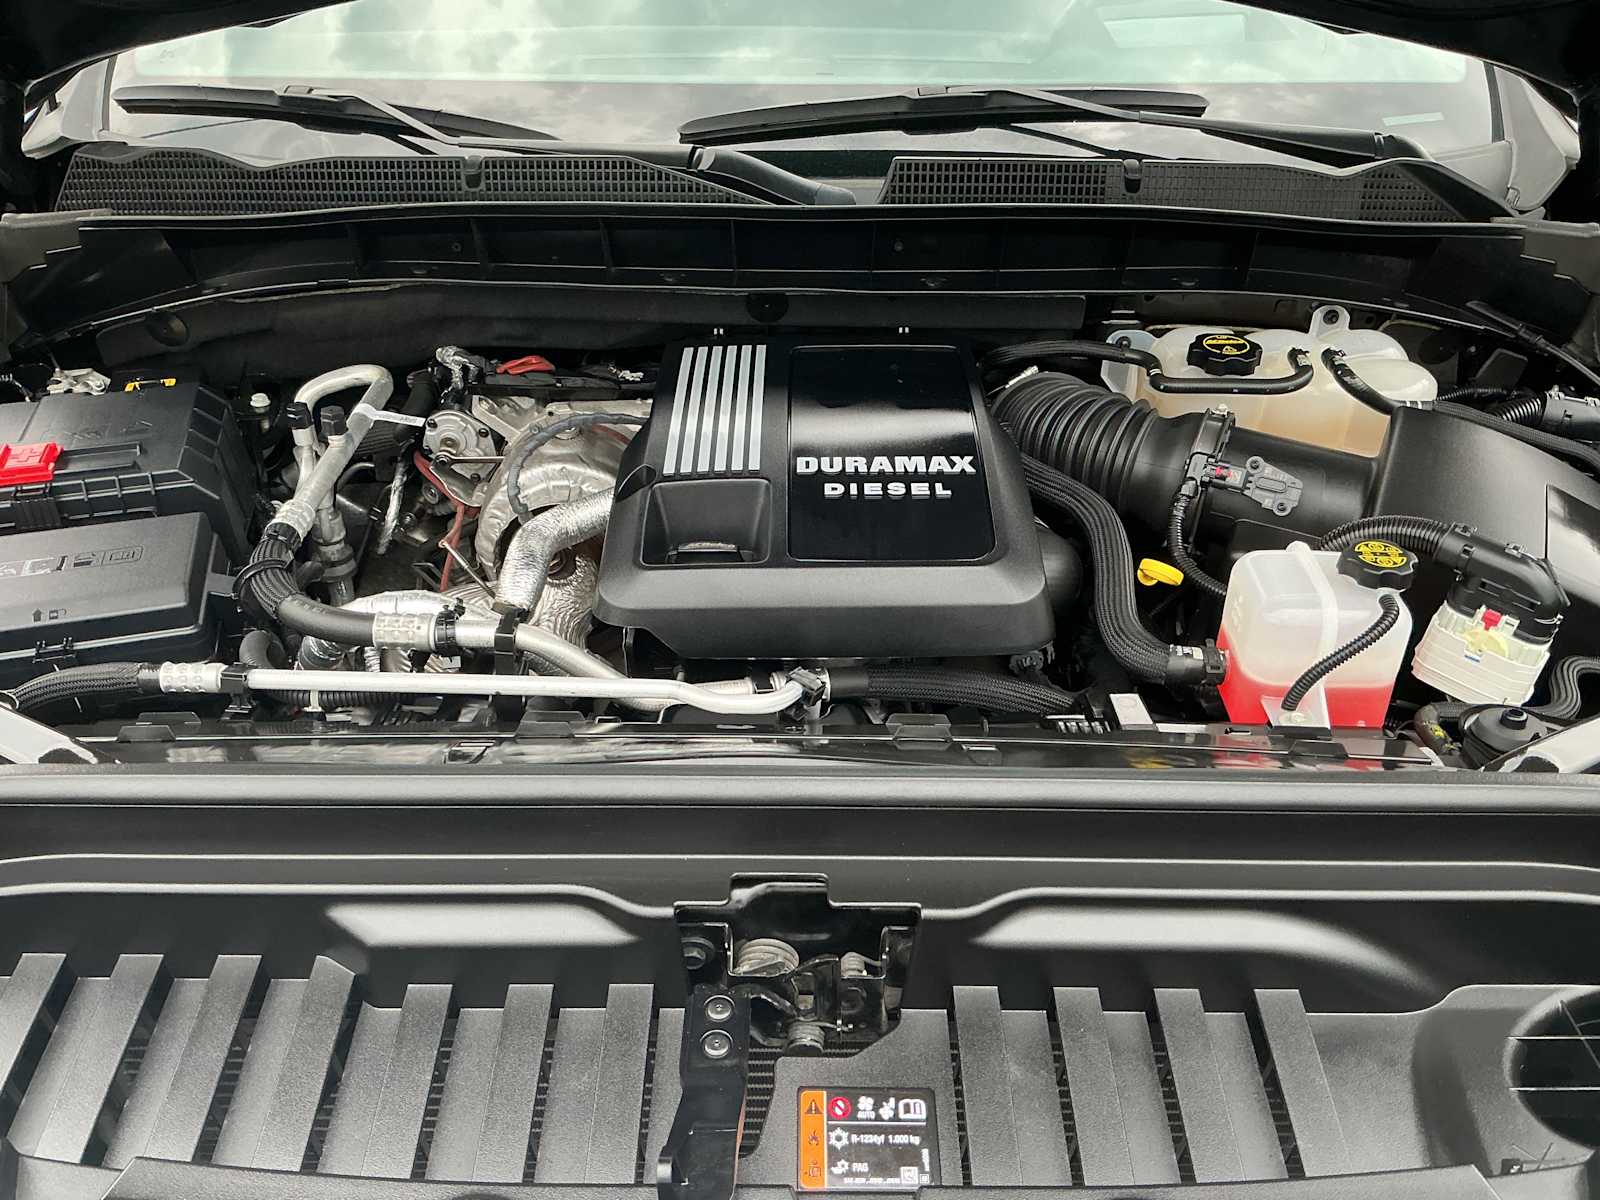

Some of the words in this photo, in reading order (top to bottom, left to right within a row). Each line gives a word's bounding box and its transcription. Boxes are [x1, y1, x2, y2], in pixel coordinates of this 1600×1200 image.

[796, 455, 976, 474] DURAMAX
[823, 482, 952, 498] DIESEL
[857, 1111, 875, 1120] AUTO
[888, 1134, 908, 1144] 1.000
[910, 1134, 920, 1146] kg
[852, 1162, 868, 1172] PAG
